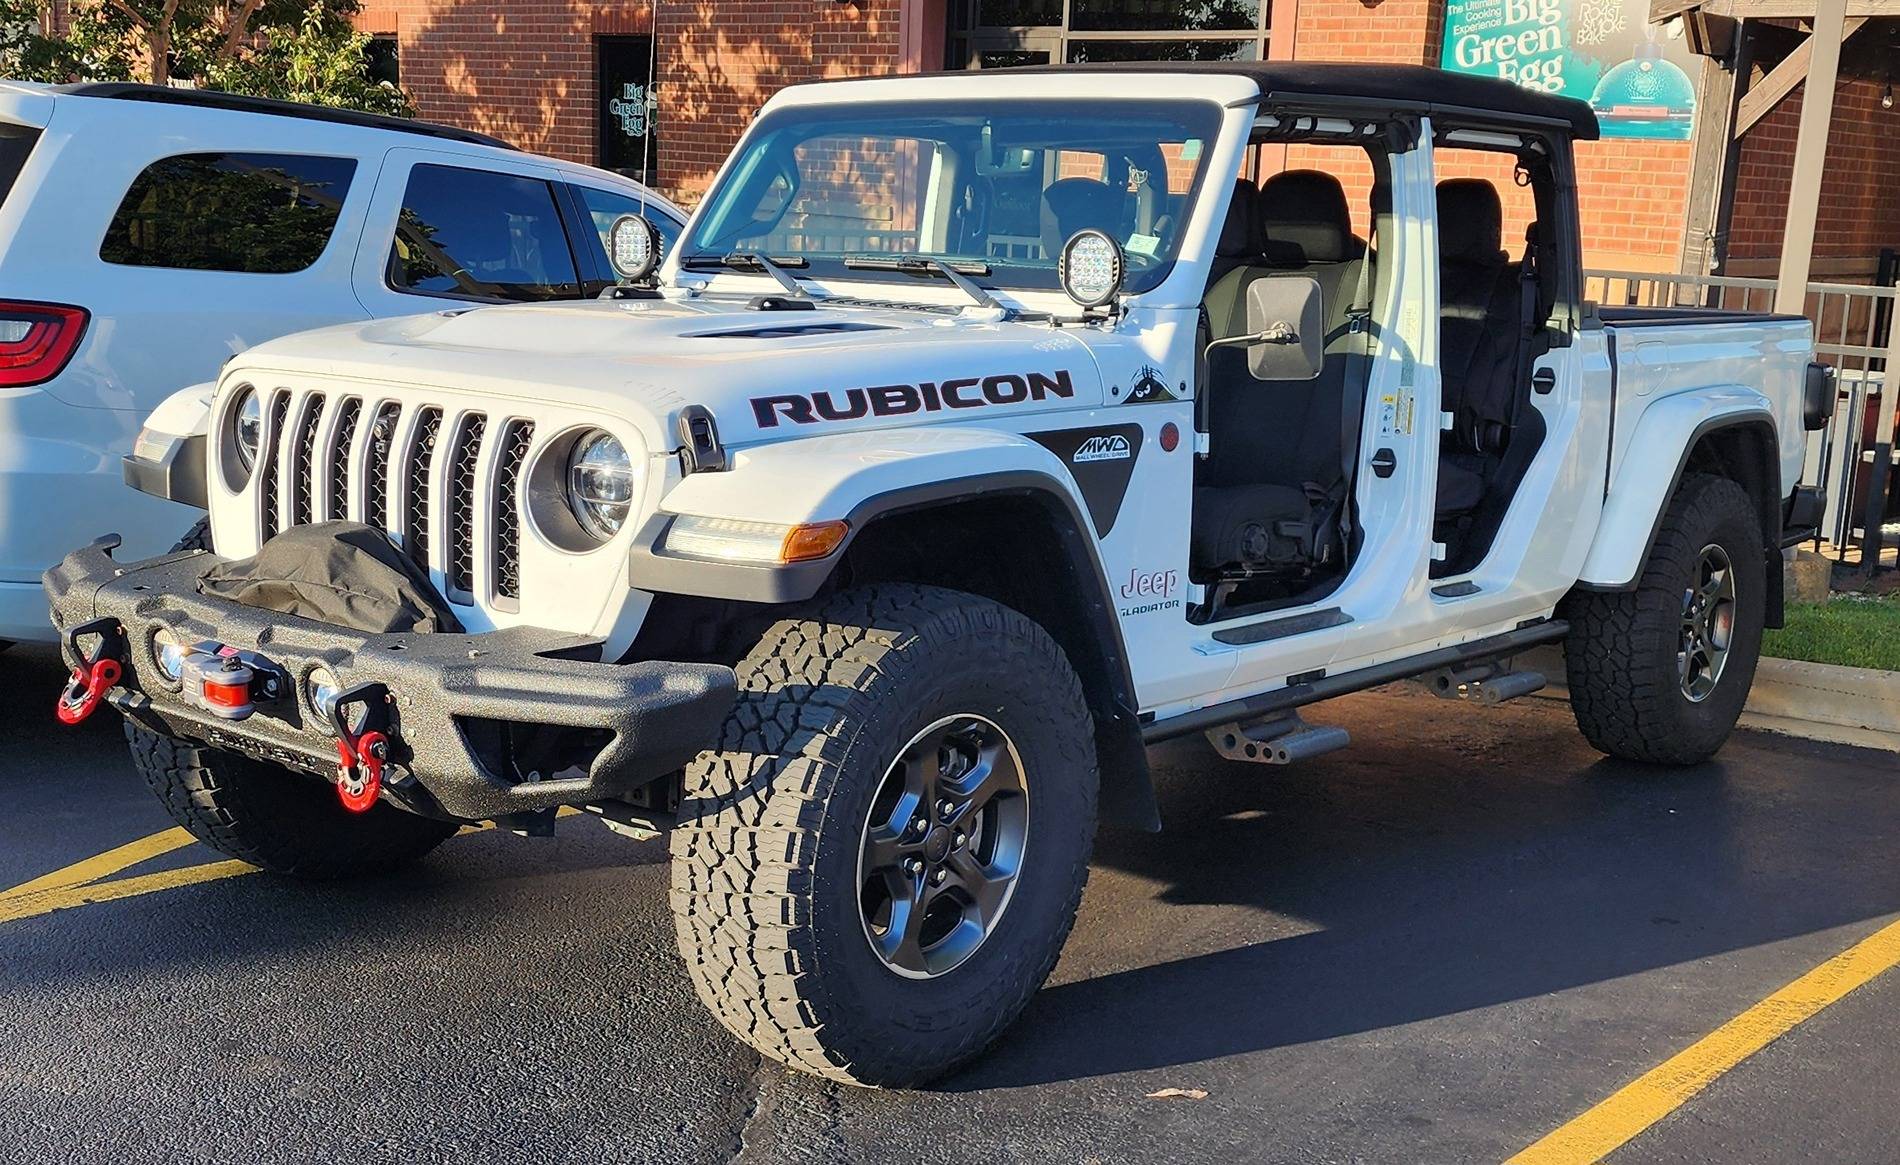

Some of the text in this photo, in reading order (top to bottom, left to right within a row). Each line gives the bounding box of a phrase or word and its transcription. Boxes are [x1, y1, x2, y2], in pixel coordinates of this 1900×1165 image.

[1448, 5, 1464, 16] The
[1466, 8, 1501, 21] Cooking
[1504, 0, 1562, 26] Big
[1579, 3, 1621, 21] ROAST
[1454, 18, 1502, 35] Experience
[1455, 25, 1563, 68] Green
[1577, 29, 1606, 46] BAKE
[1497, 55, 1564, 93] Egg
[623, 83, 643, 104] Big
[610, 98, 643, 116] Green
[622, 114, 643, 136] Egg
[750, 369, 1074, 429] RUBICON
[1076, 437, 1129, 455] MWD
[1121, 568, 1176, 599] Jeep
